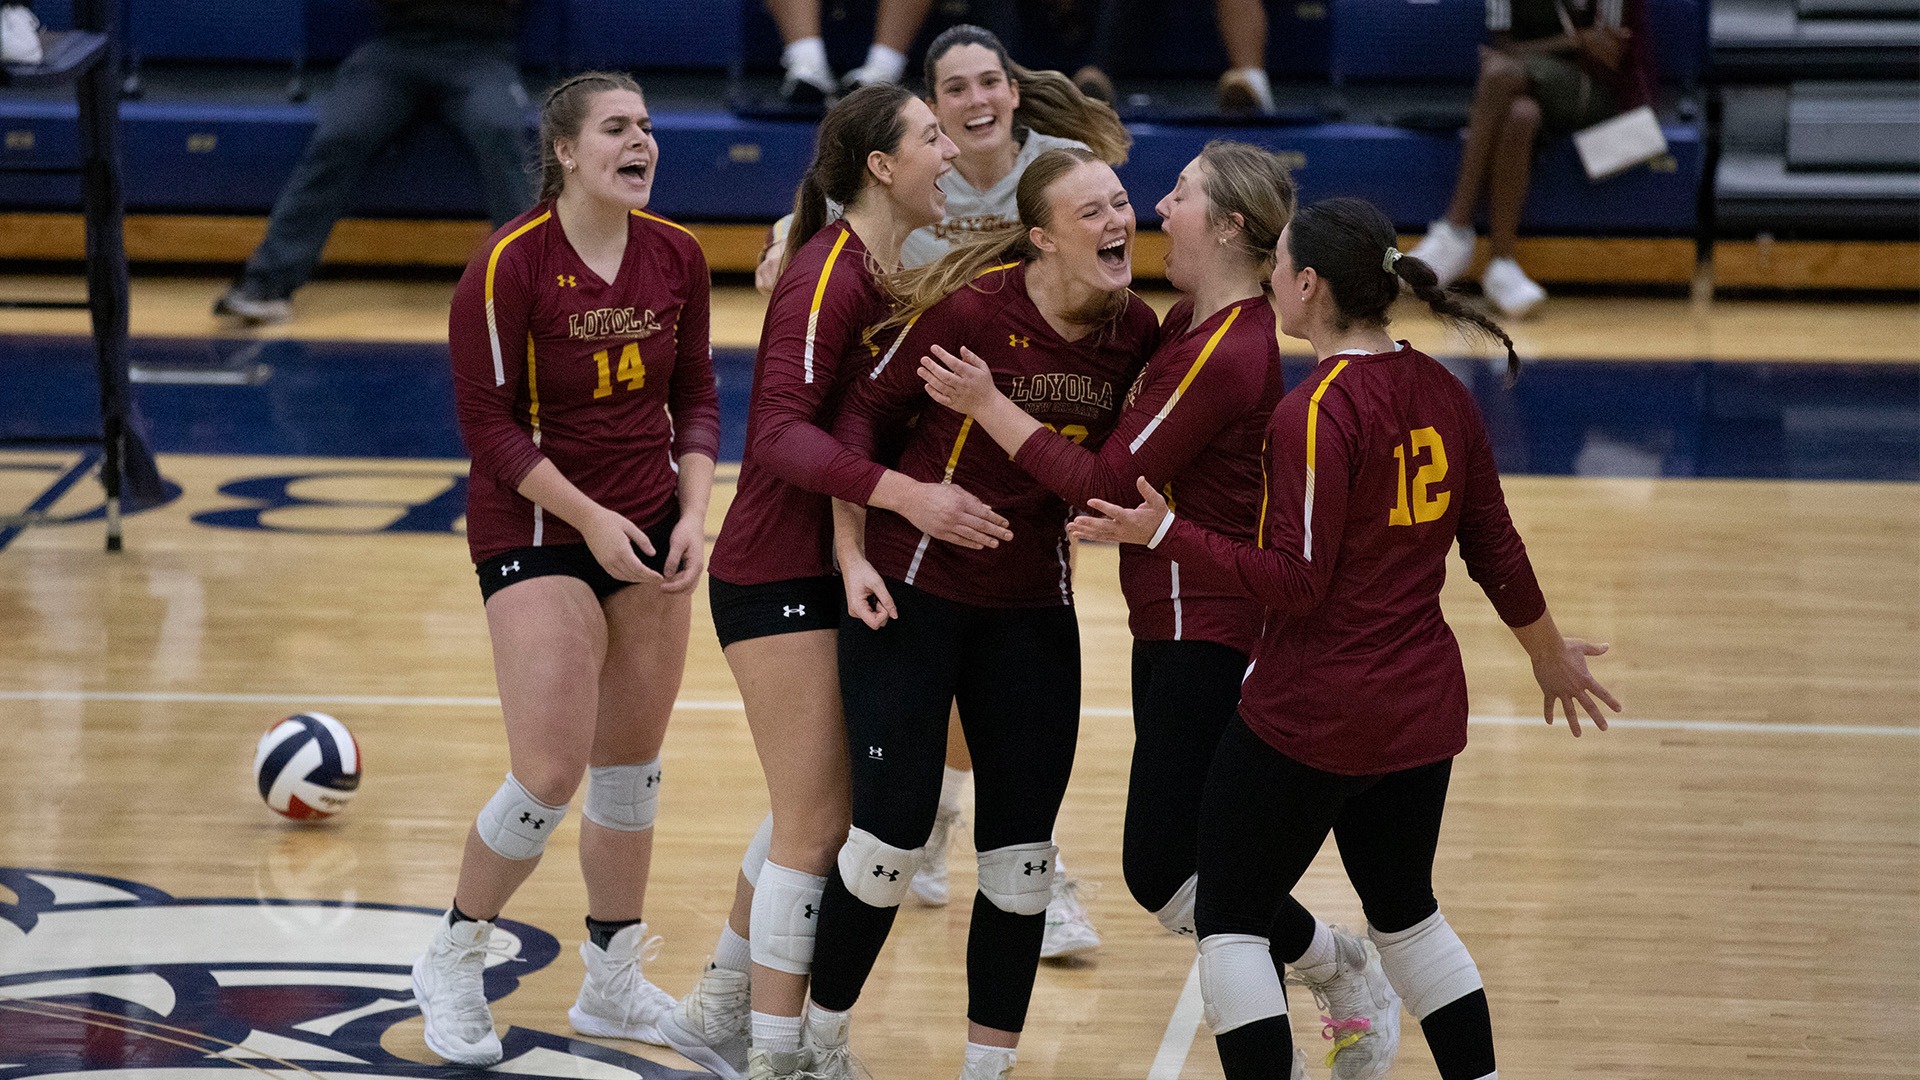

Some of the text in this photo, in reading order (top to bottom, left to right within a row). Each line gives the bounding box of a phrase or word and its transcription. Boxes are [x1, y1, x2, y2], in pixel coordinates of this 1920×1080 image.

[568, 307, 662, 339] LOYOLA
[593, 341, 646, 399] 14
[1009, 373, 1114, 411] LOYOLA
[1024, 402, 1051, 414] NEW
[1388, 426, 1451, 527] 12
